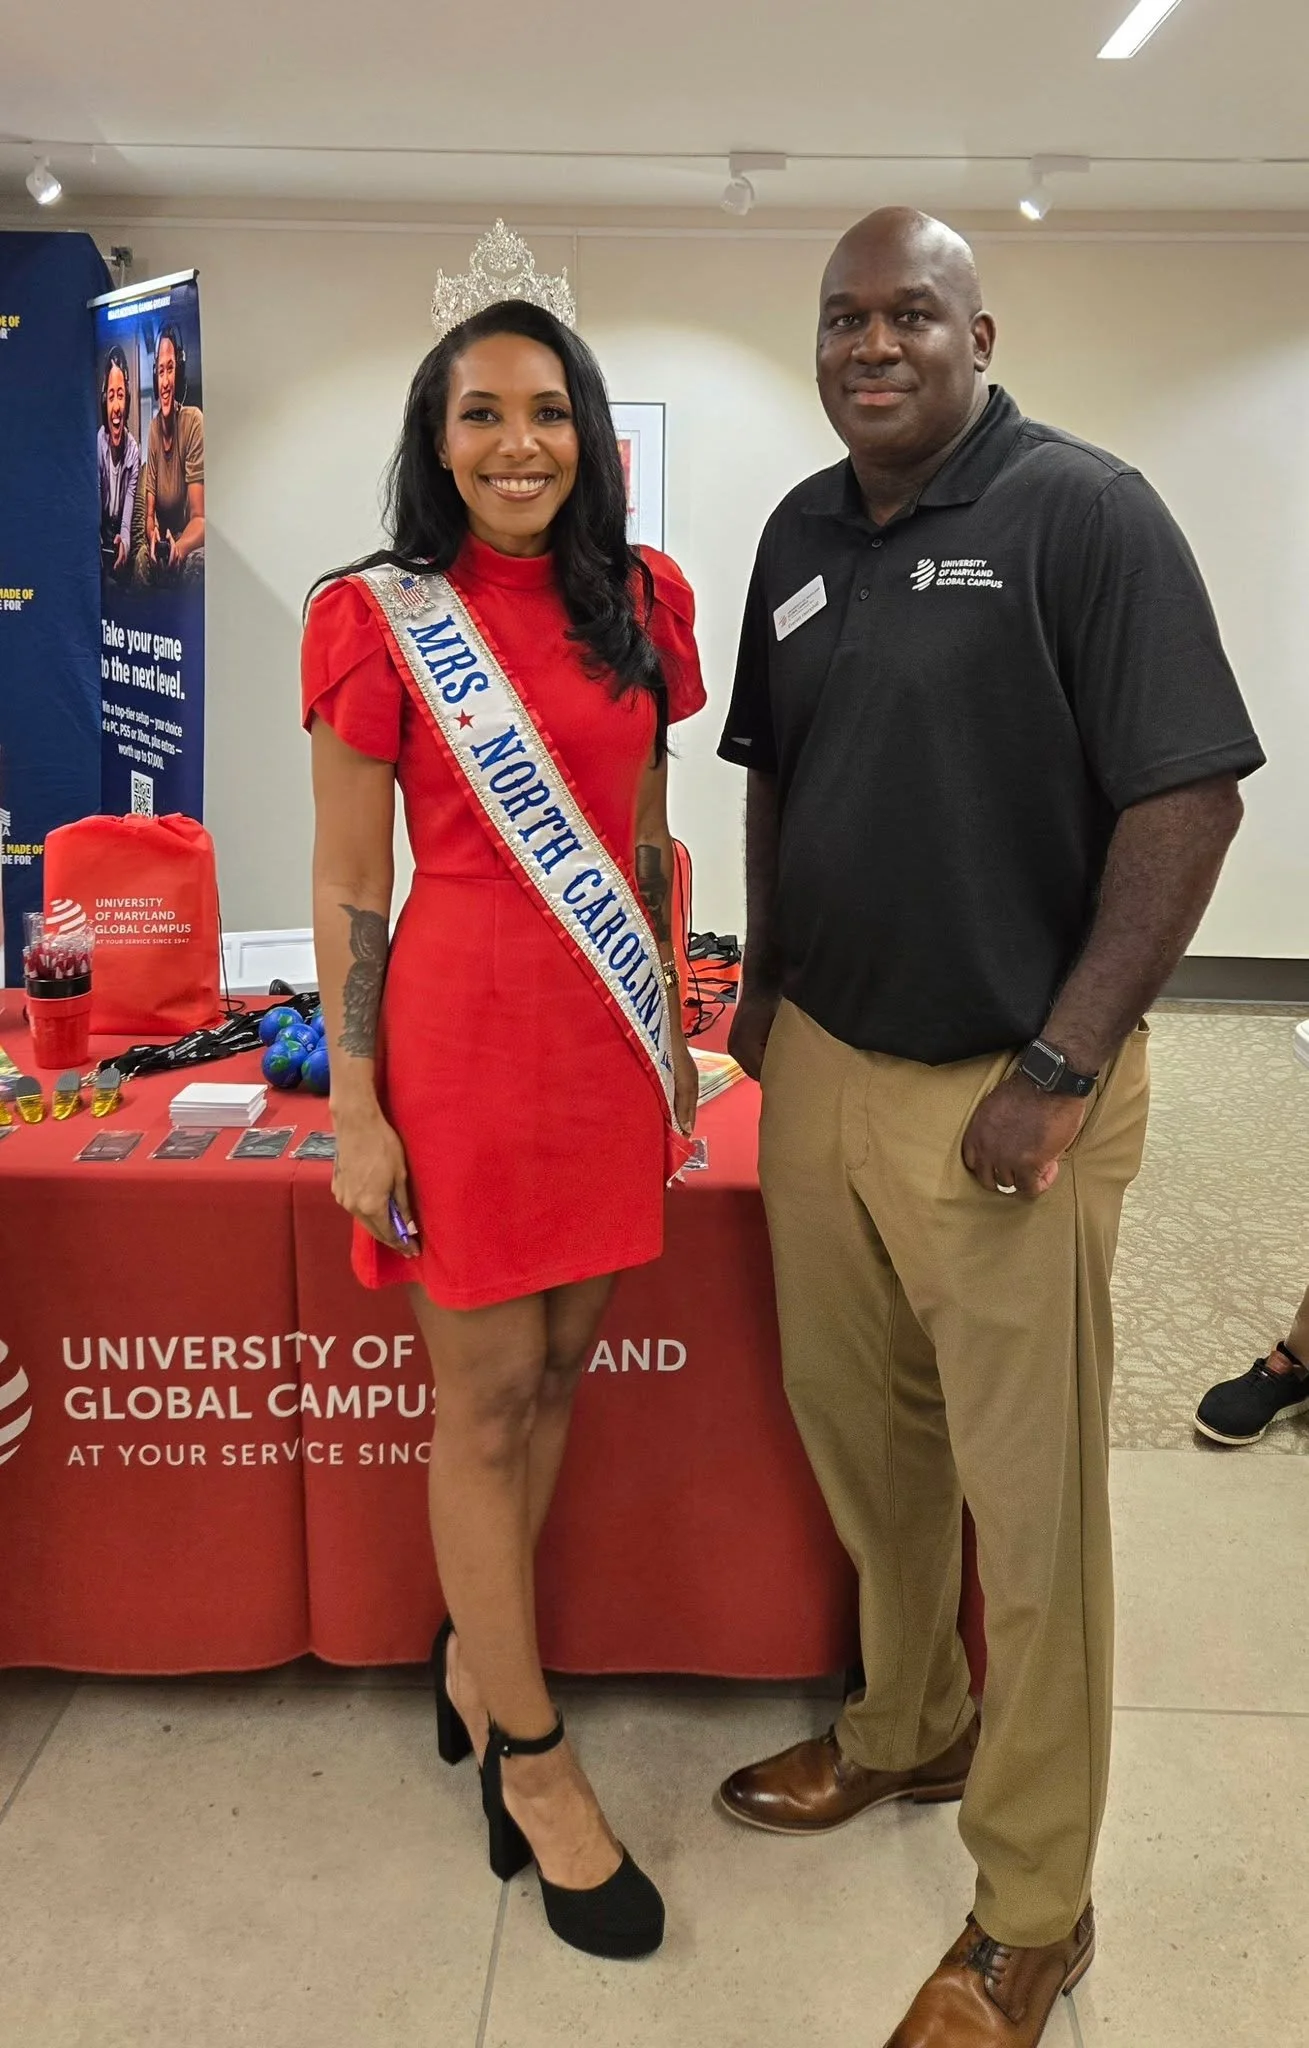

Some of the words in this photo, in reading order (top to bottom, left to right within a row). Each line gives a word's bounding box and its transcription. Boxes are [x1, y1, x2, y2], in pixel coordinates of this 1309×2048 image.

[8, 315, 21, 328] OF
[941, 560, 987, 568] UNIVERSITY
[938, 568, 950, 577] OF
[950, 568, 994, 577] MARYLAND
[936, 578, 966, 586] GLOBAL
[967, 578, 1003, 589] CAMPUS
[21, 589, 34, 600] OF
[101, 619, 125, 649] Take
[126, 629, 152, 655] your
[153, 634, 182, 662] game
[406, 614, 491, 704] MRS
[101, 653, 110, 680] to
[111, 655, 131, 685] the
[132, 665, 155, 692] next
[156, 665, 186, 700] level.
[164, 720, 183, 738] choice
[469, 724, 584, 876] NORTH
[6, 844, 32, 855] MADE
[32, 845, 44, 855] OF
[95, 897, 164, 908] UNIVERSITY
[94, 911, 112, 922] OF
[113, 910, 176, 921] MARYLAND
[94, 924, 140, 935] GLOBAL
[142, 923, 192, 934] CAMPUS
[62, 1331, 337, 1371] UNIVERSITY
[352, 1334, 415, 1370] OF
[64, 1386, 253, 1420] GLOBAL
[67, 1445, 104, 1466] AT
[118, 1444, 207, 1466] YOUR
[222, 1437, 344, 1466] SERVICE
[358, 1442, 432, 1466] SINC
